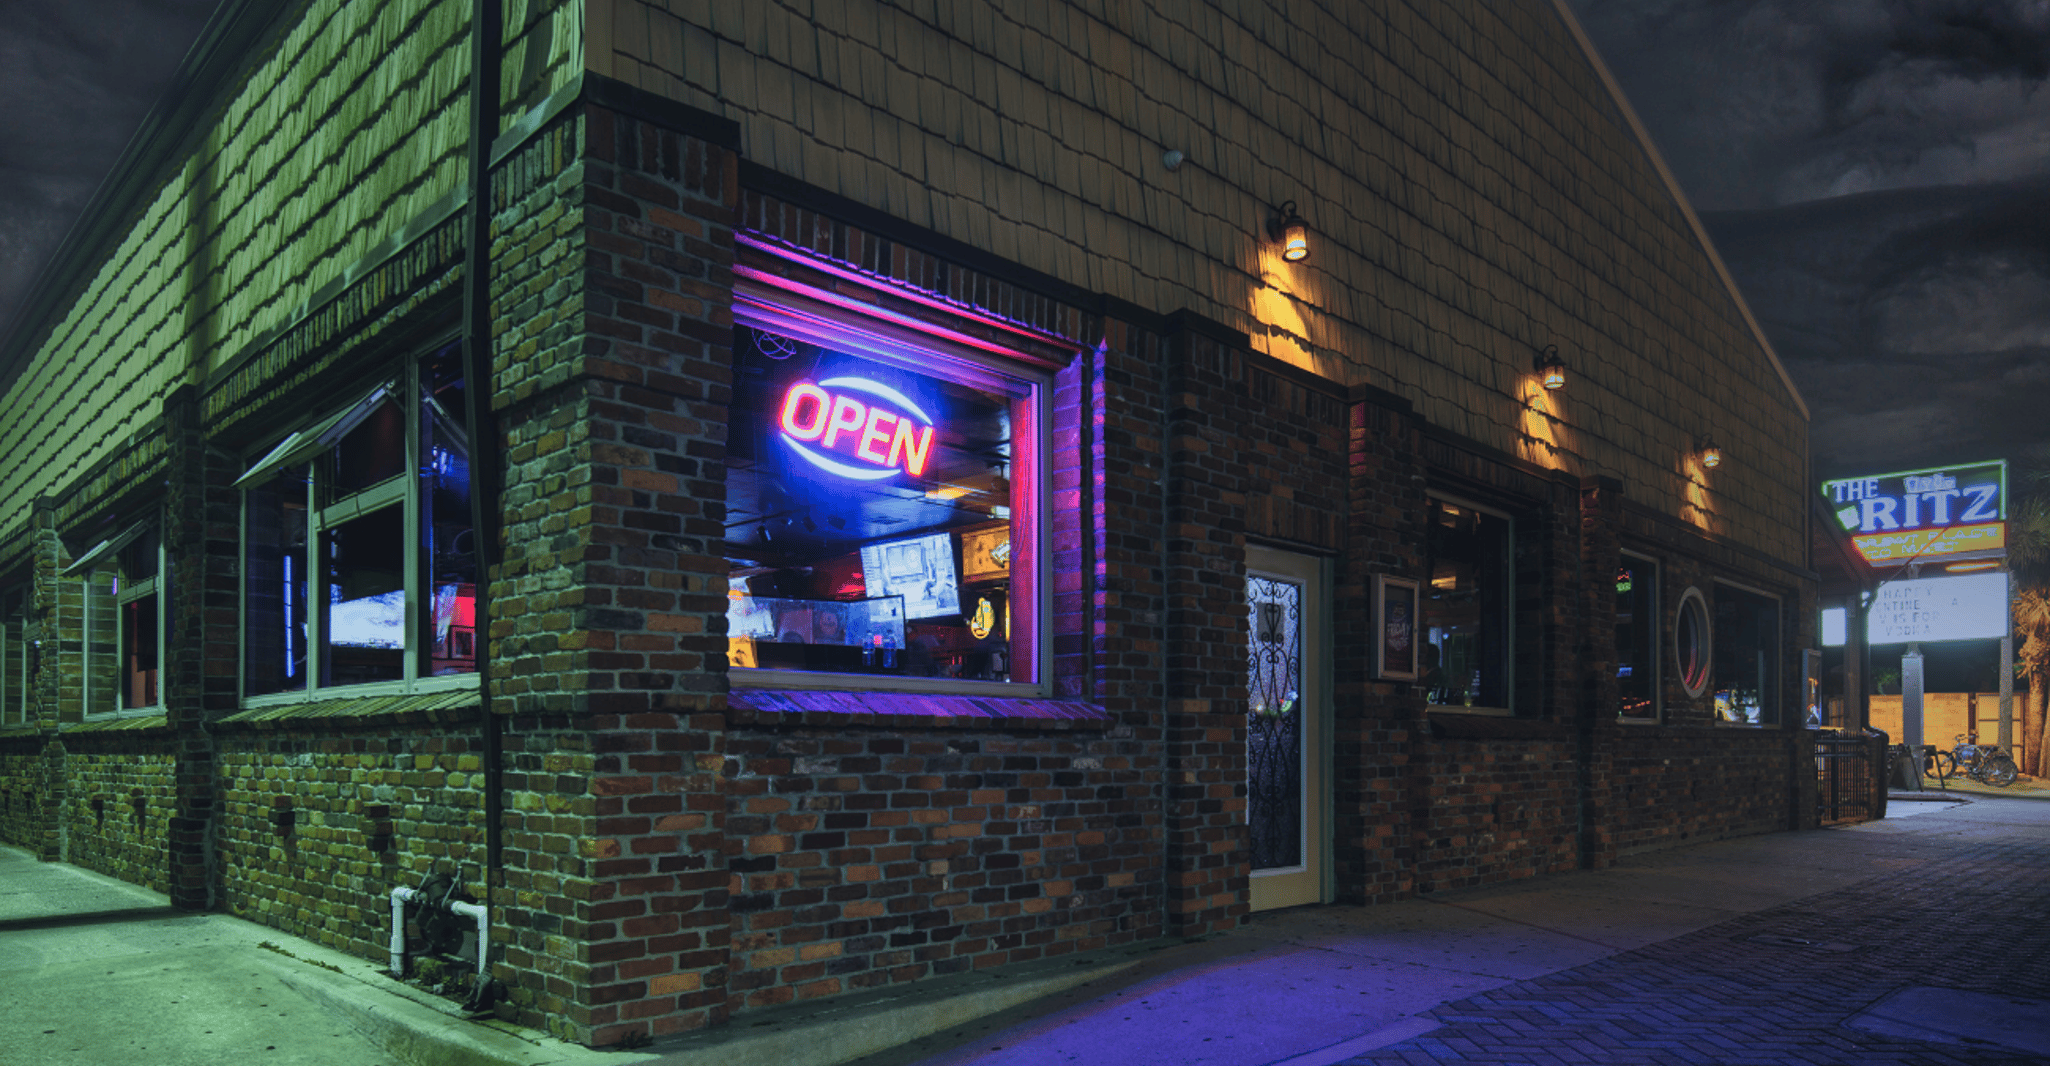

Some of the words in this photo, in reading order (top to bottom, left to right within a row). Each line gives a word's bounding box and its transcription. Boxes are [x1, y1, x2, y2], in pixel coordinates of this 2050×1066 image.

[782, 383, 933, 476] OPEN
[1832, 479, 1878, 502] THE
[1860, 485, 1998, 531] RITZ
